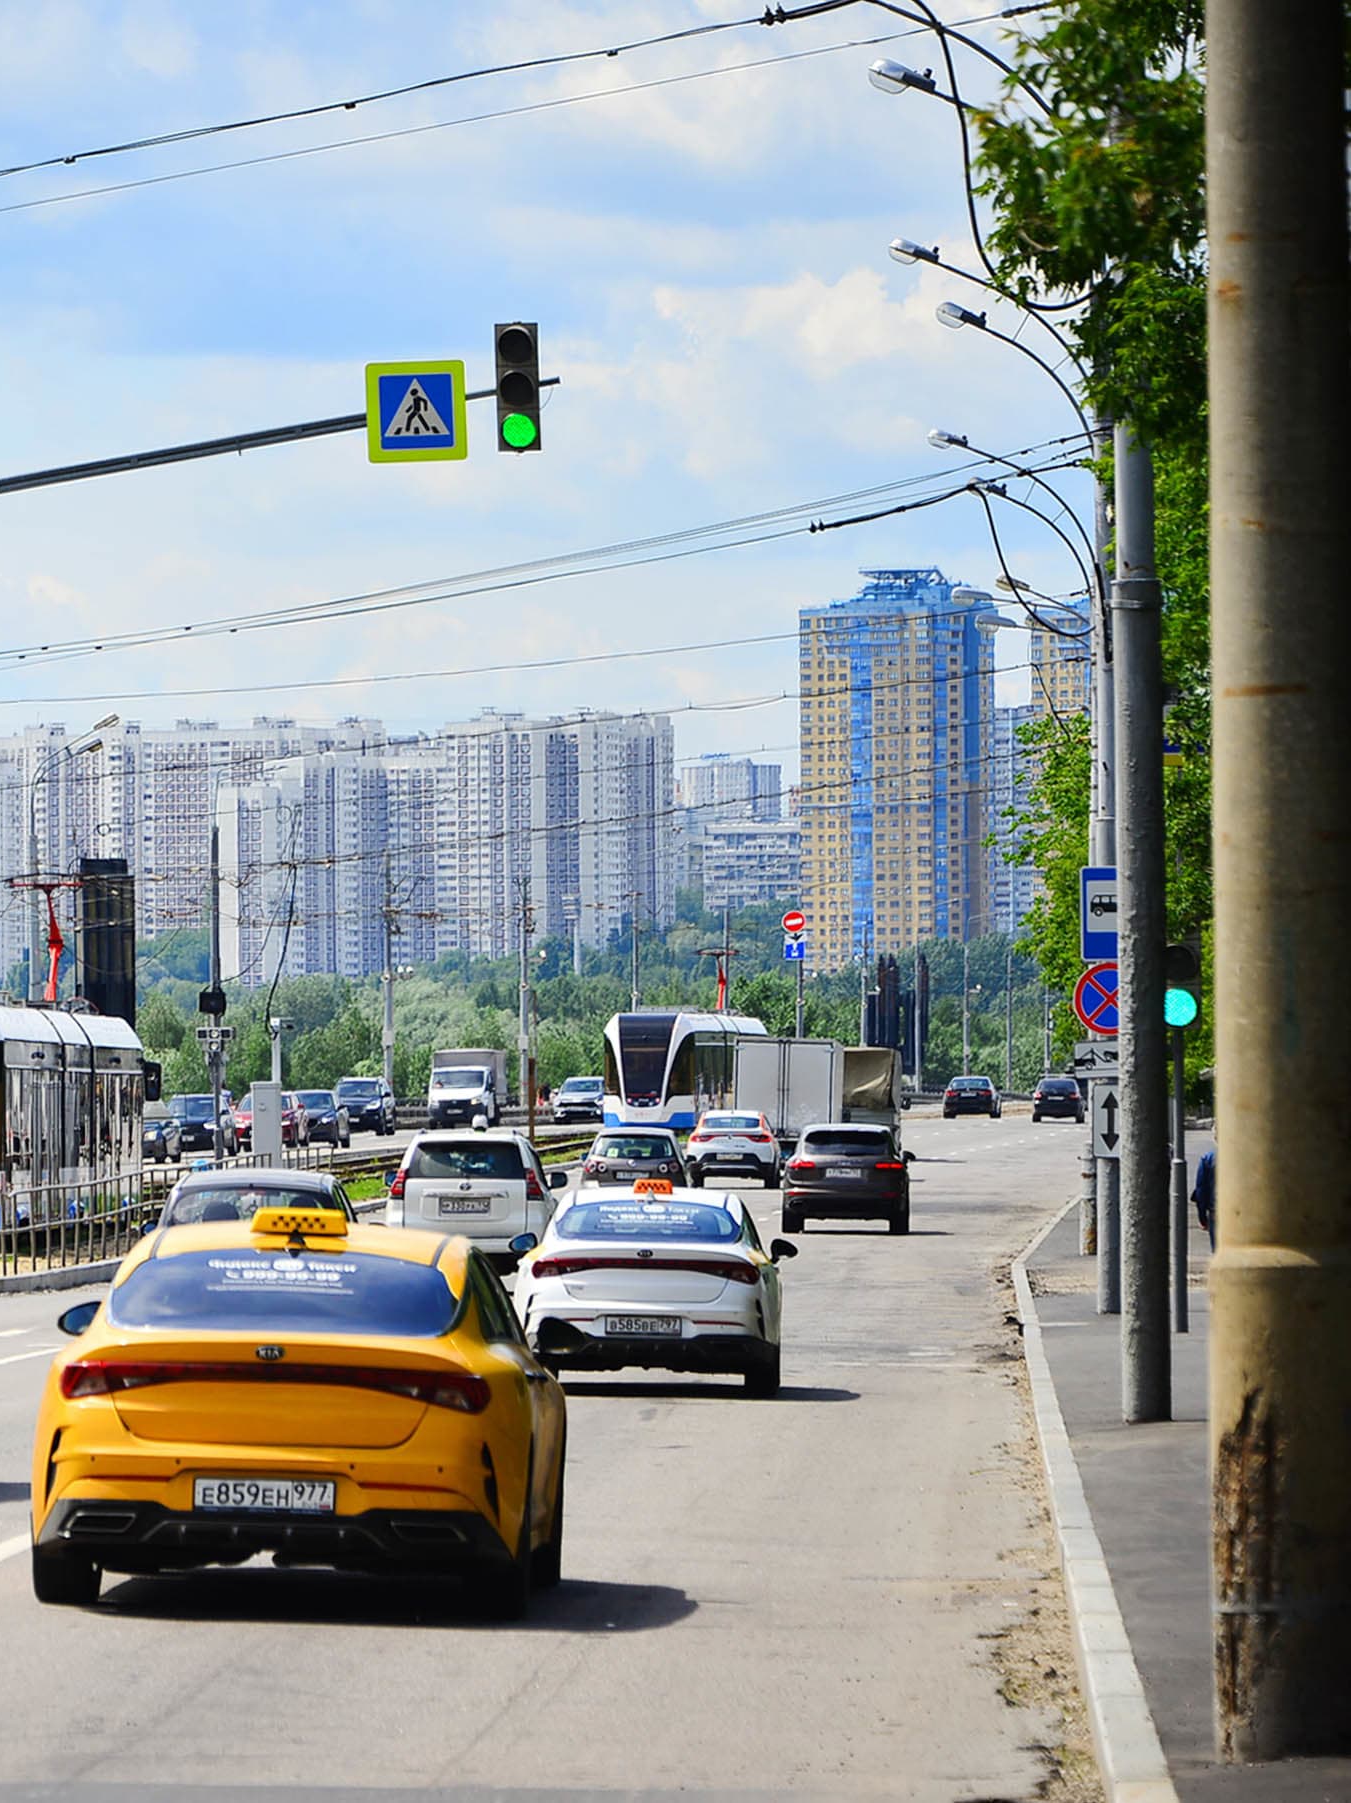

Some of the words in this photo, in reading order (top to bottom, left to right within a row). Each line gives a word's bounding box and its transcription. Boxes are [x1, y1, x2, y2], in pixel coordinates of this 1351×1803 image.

[257, 1346, 281, 1359] KIA
[201, 1482, 290, 1506] Е859ЕН
[294, 1483, 329, 1500] 977
